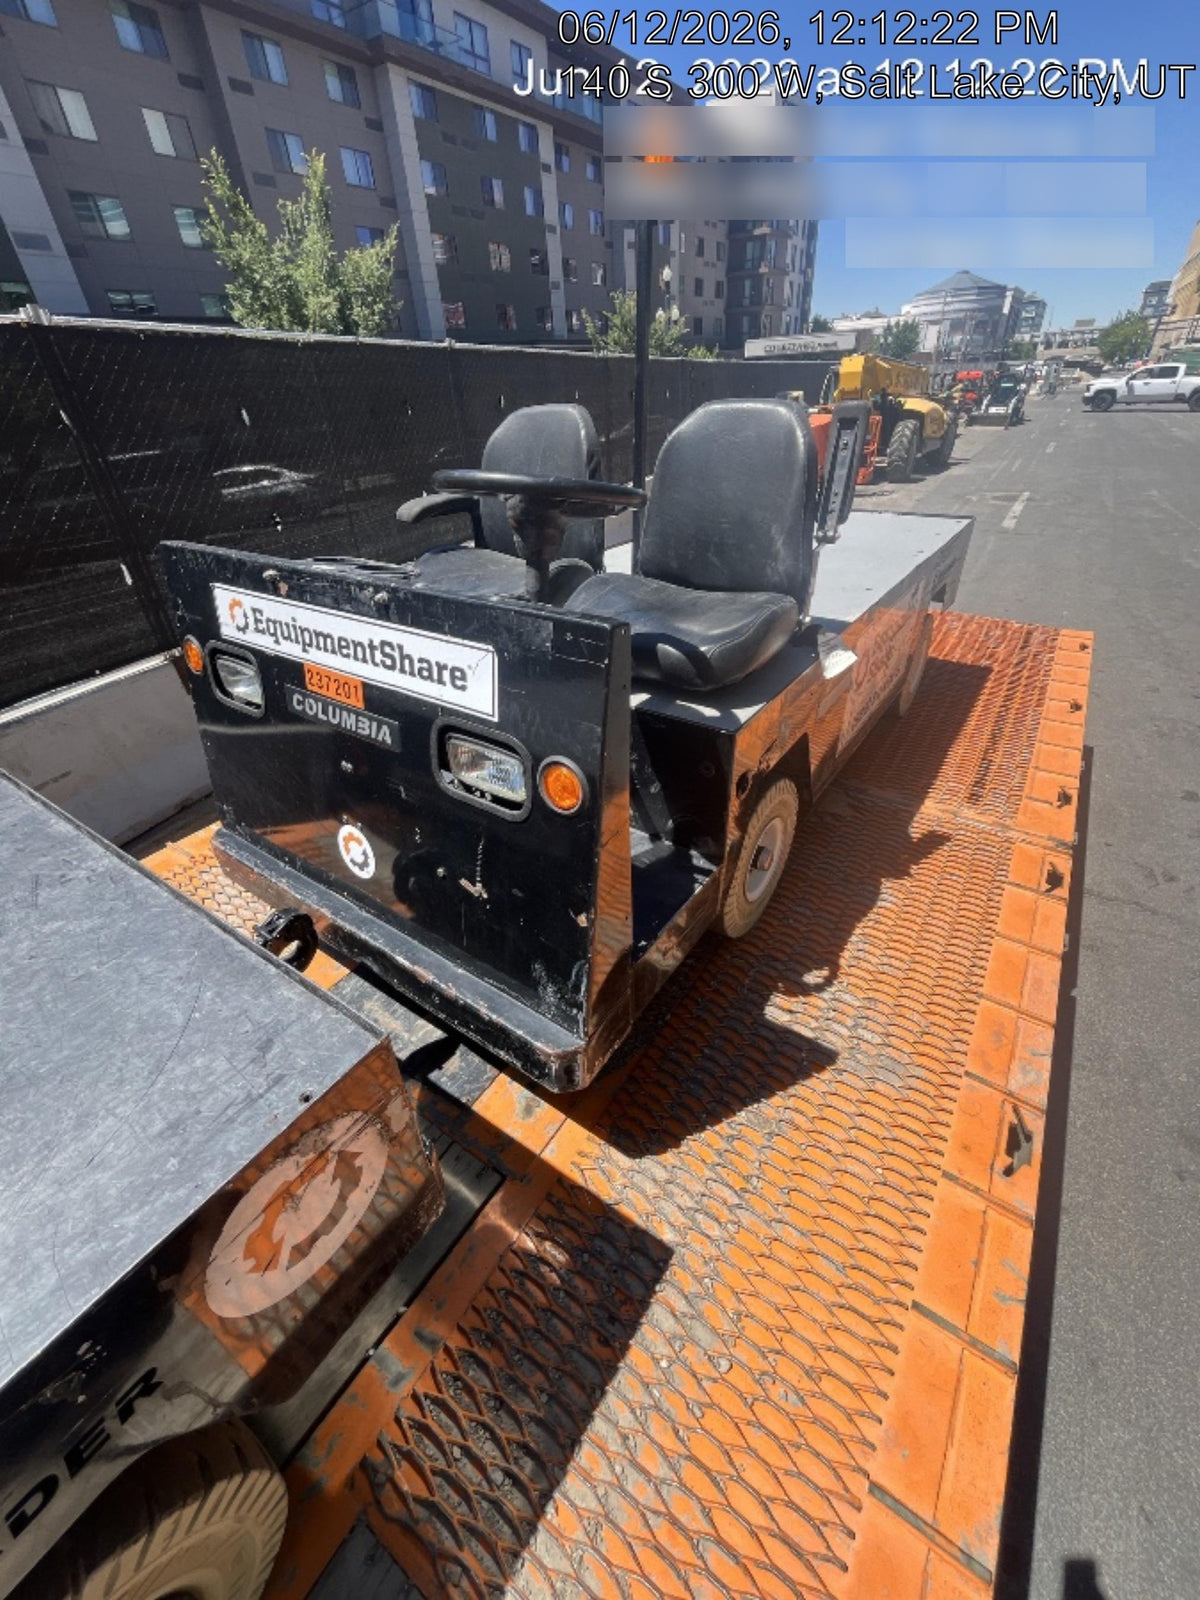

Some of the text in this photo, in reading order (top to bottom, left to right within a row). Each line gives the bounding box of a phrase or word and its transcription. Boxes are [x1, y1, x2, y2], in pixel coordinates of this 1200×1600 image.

[251, 606, 468, 692] EquipmentShare
[292, 693, 392, 745] COLUMBIA
[307, 668, 360, 703] 237201
[0, 1366, 164, 1555] DER
